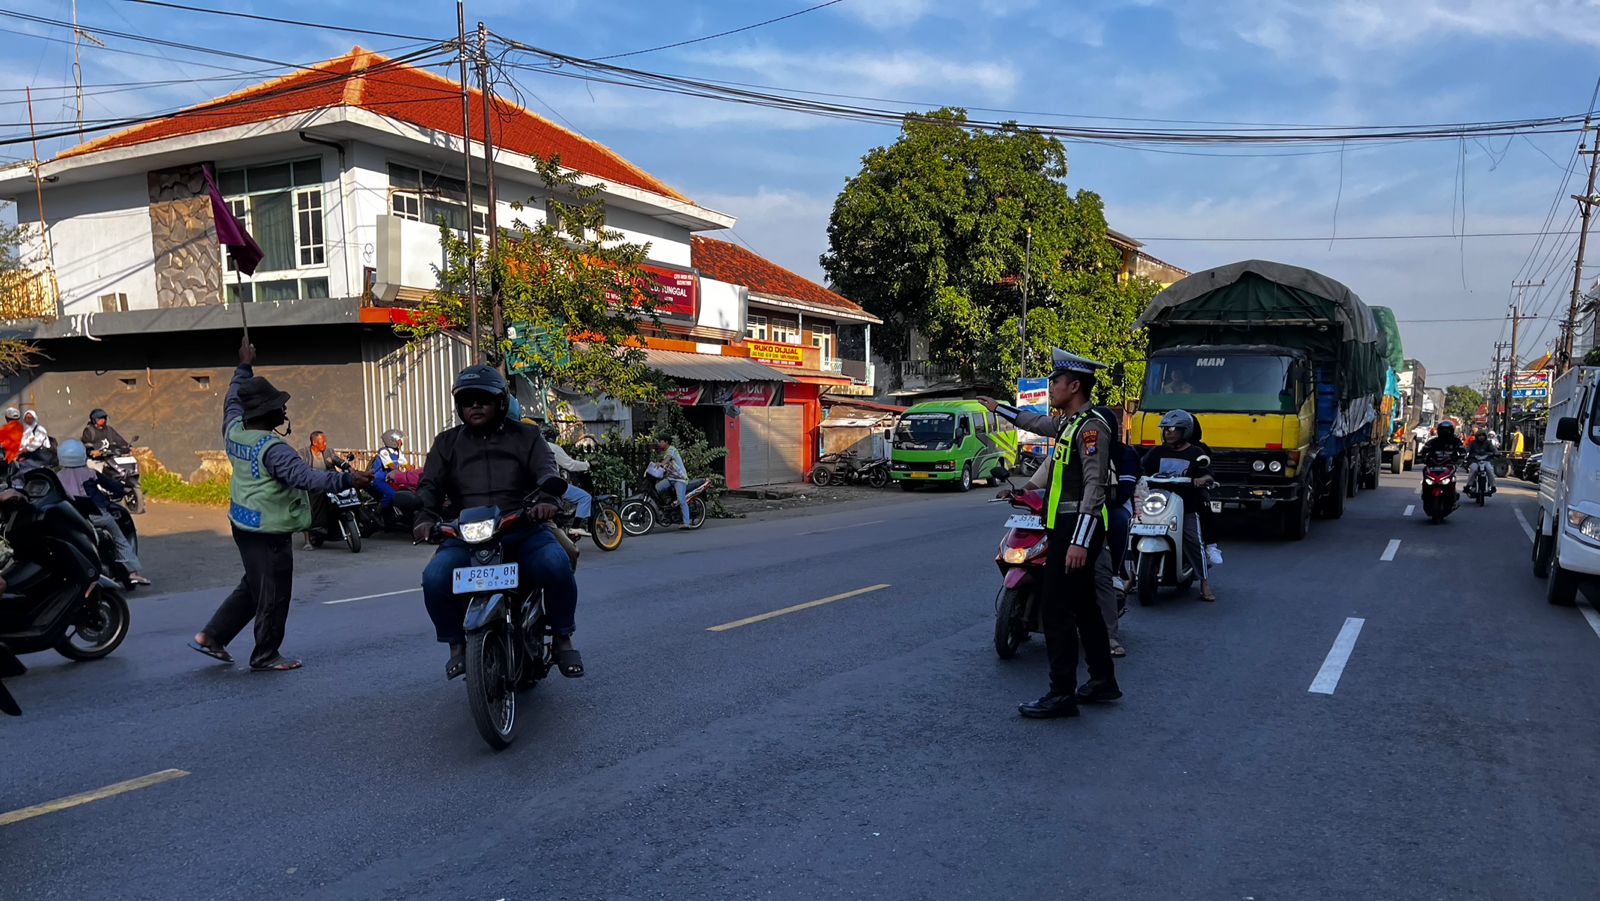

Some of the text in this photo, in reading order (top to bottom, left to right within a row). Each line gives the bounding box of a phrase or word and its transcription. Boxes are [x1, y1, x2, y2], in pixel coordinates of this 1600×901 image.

[753, 344, 799, 355] RUKO DIJUAL
[1196, 357, 1226, 367] MAN
[455, 571, 461, 581] N
[470, 568, 495, 579] 6267
